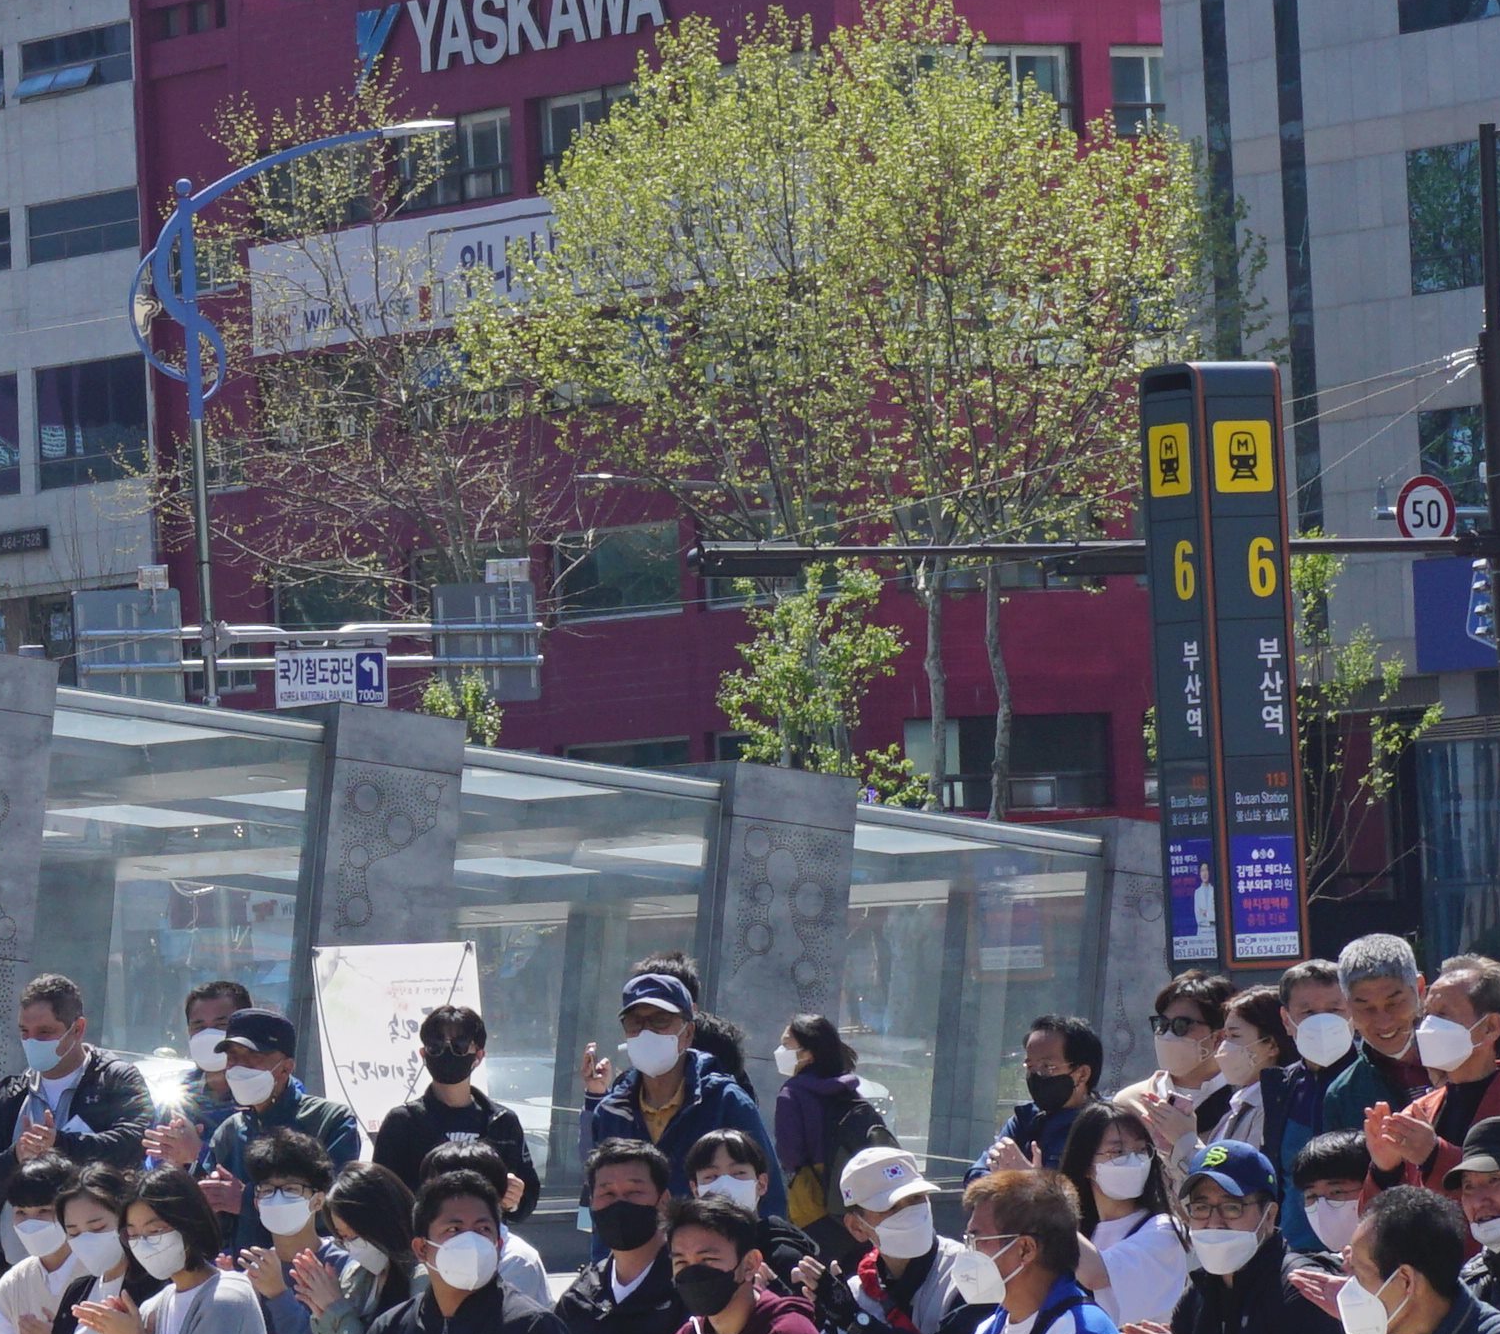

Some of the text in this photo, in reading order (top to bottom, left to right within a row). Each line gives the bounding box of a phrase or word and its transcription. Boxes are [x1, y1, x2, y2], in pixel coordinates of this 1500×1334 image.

[1411, 499, 1442, 528] 50
[1174, 540, 1195, 600] 6
[1248, 537, 1277, 597] 6
[279, 657, 354, 686] 국가철도공단
[1257, 637, 1284, 735] 부산역
[358, 689, 384, 701] 700m
[1183, 640, 1203, 738] 부산역
[1265, 772, 1288, 786] 113
[1235, 790, 1289, 805] Busan Station
[1274, 879, 1293, 891] 의원
[1238, 943, 1298, 956] 051.634.8275
